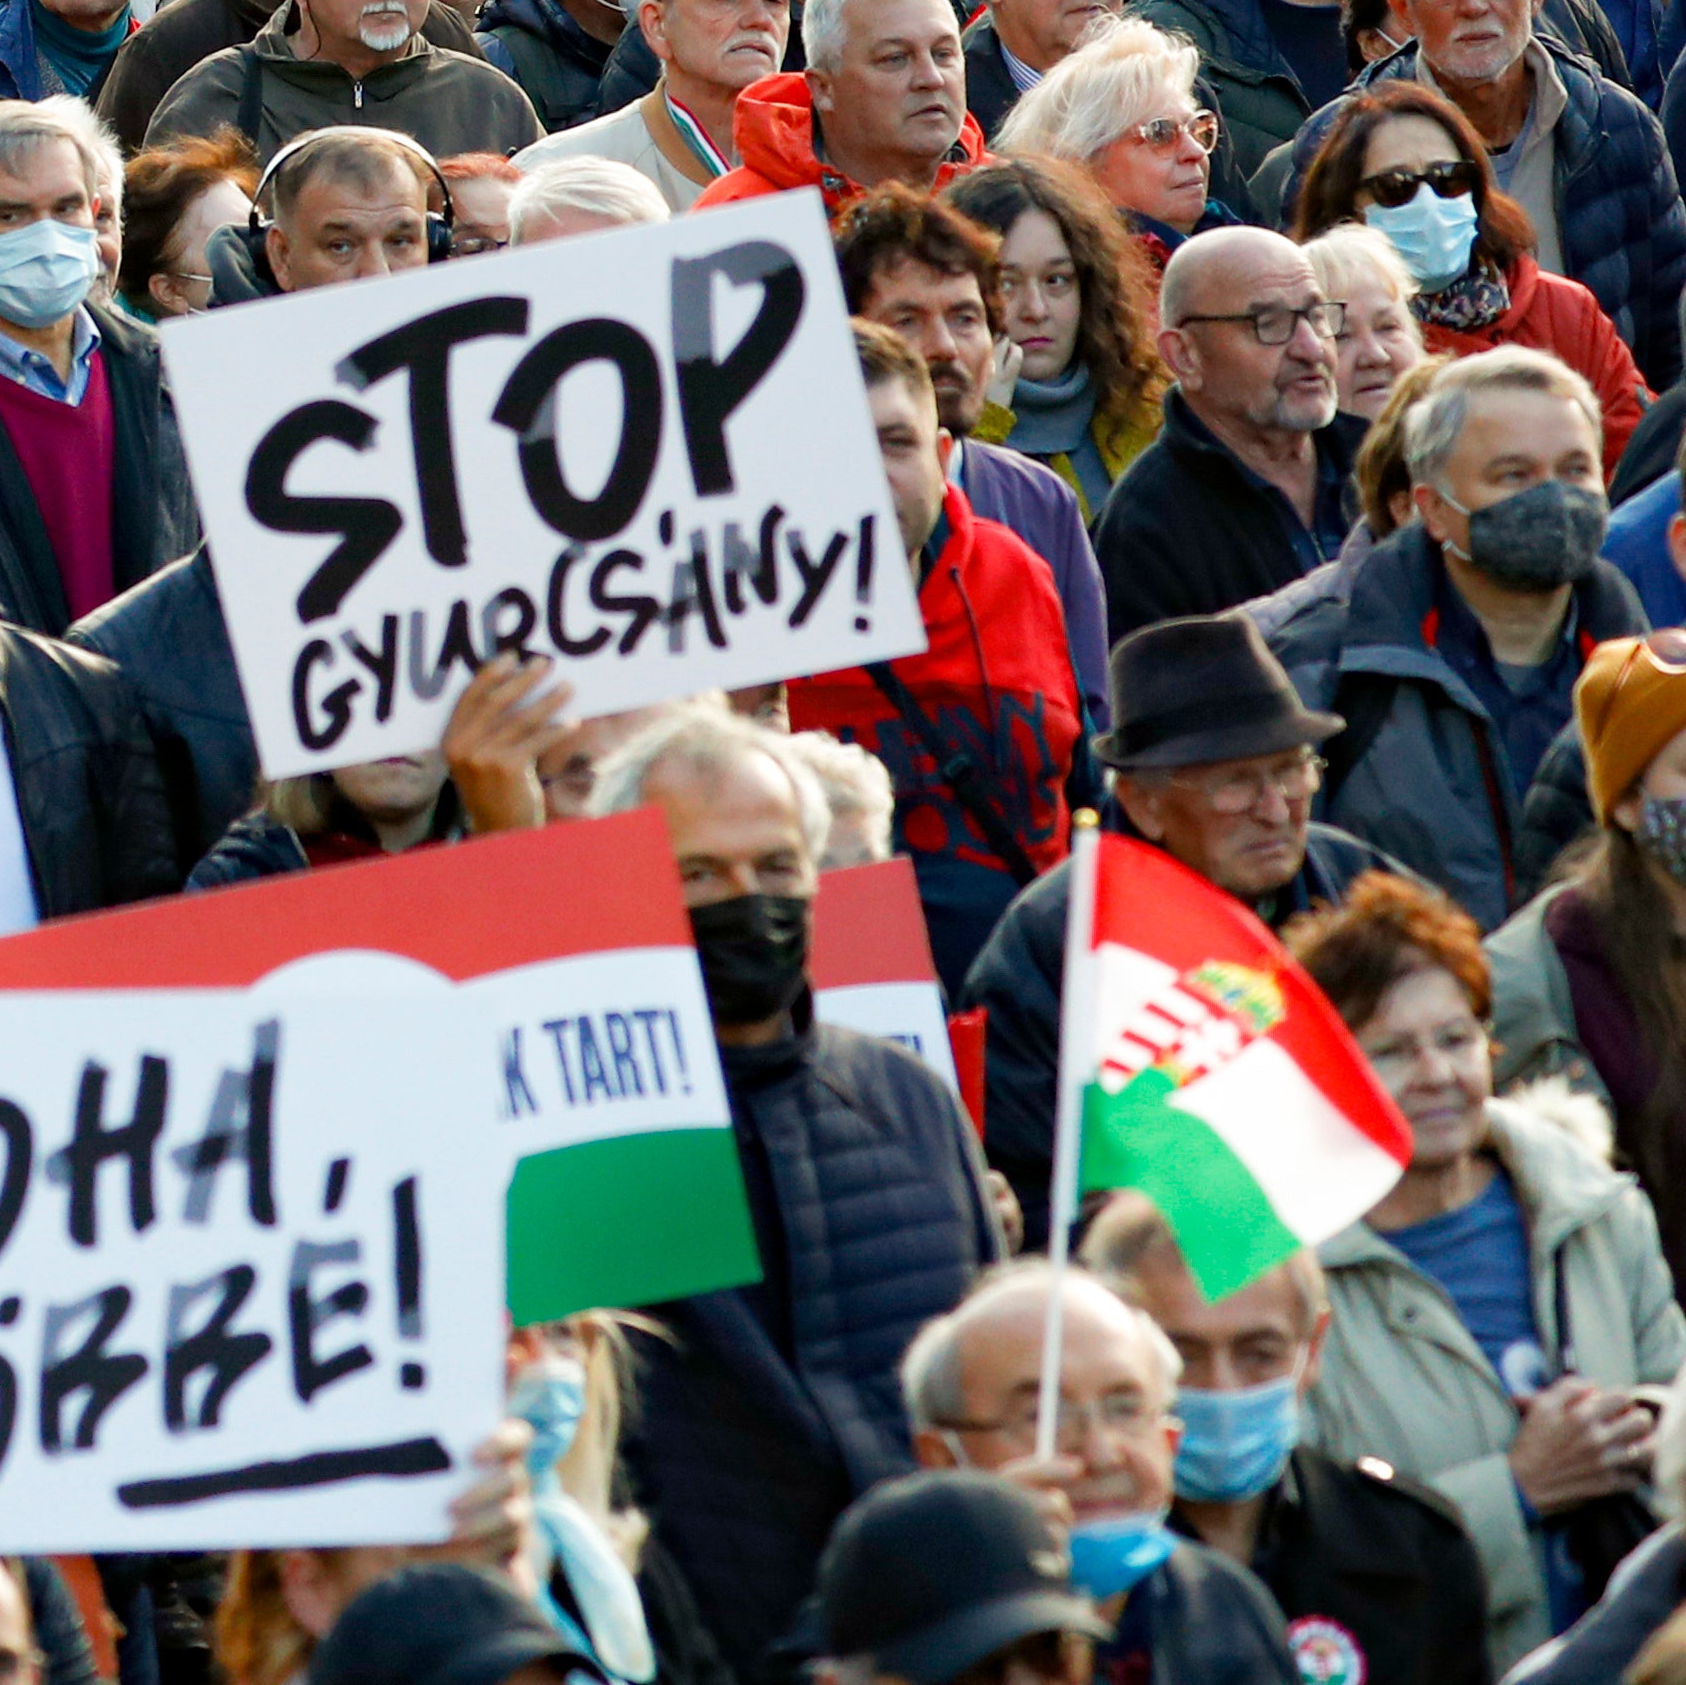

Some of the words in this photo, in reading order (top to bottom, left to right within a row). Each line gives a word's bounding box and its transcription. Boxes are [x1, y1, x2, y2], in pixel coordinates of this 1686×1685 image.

[244, 240, 807, 624] STOP
[291, 503, 878, 754] GYURCSÁNY!
[542, 1009, 693, 1105] TART!
